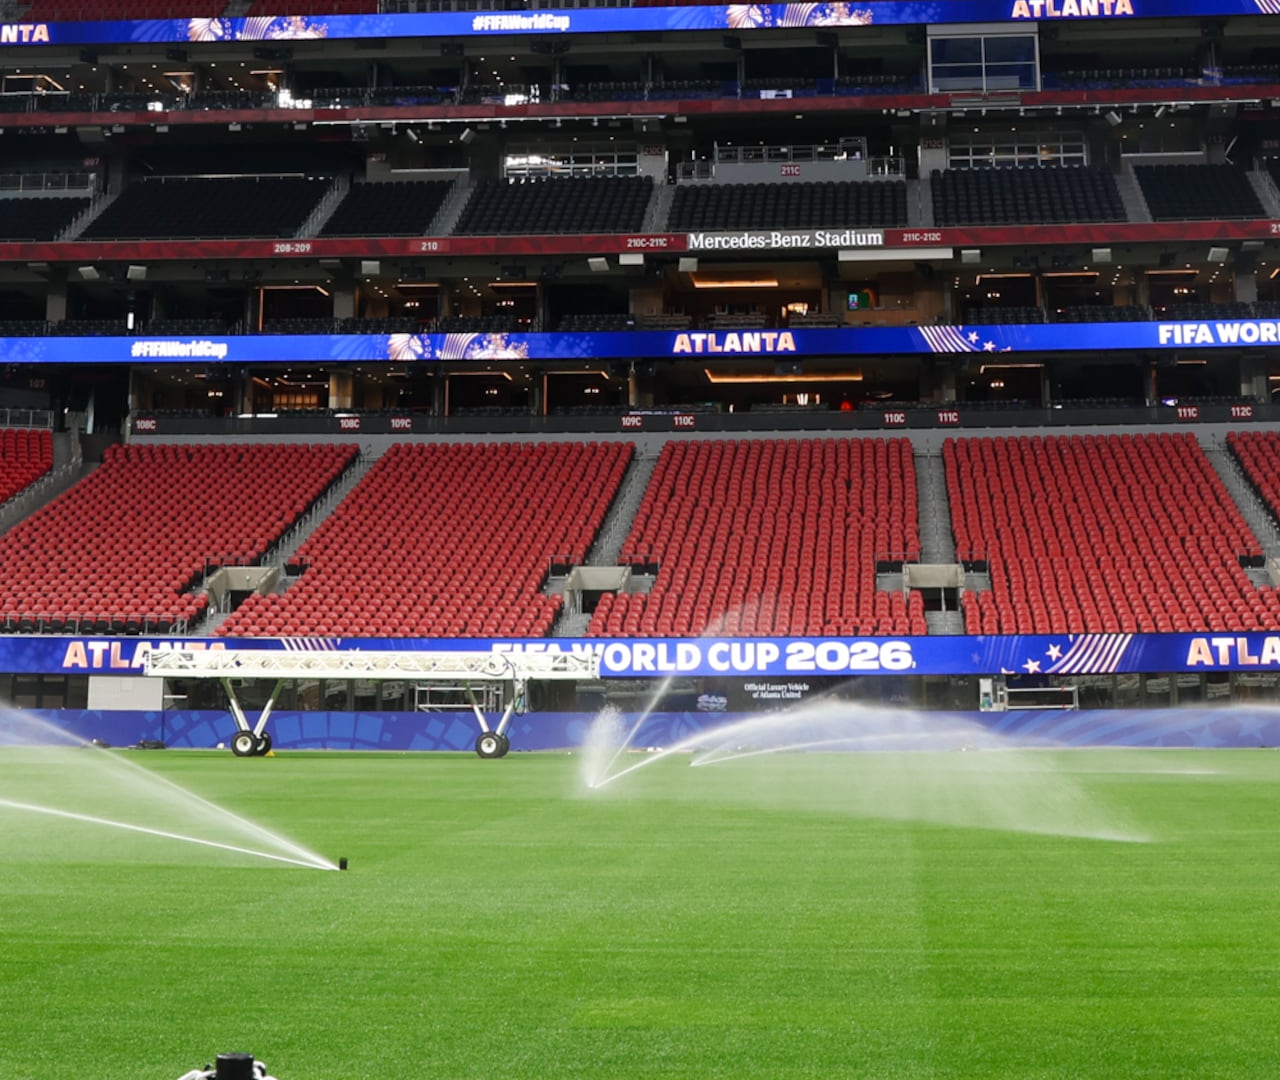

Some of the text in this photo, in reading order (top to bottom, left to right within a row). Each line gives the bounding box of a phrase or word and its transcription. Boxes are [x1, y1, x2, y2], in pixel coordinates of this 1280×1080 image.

[472, 13, 570, 32] #FIFAWorldCup
[781, 166, 800, 176] 211C
[627, 238, 667, 247] 210C-211C
[689, 230, 883, 248] Mercedes-Benz Stadium
[903, 233, 941, 242] 211C-212C
[274, 243, 311, 253] 208-209
[421, 242, 438, 251] 210
[1159, 323, 1214, 344] FIFA
[673, 331, 796, 353] ATLANTA
[131, 339, 227, 359] #FIFAWorldCup
[938, 412, 958, 422] 111C
[1177, 408, 1198, 418] 111C
[1231, 407, 1252, 417] 112C
[391, 418, 412, 428] 109C
[621, 416, 642, 427] 109C
[673, 416, 694, 426] 110C
[884, 413, 905, 423] 110C
[136, 420, 157, 429] 108C
[340, 419, 360, 428] 108C
[63, 641, 226, 669] ATLA
[707, 642, 780, 672] CUP
[786, 640, 913, 671] 2026
[744, 683, 766, 691] Official
[788, 683, 809, 691] Vehicle
